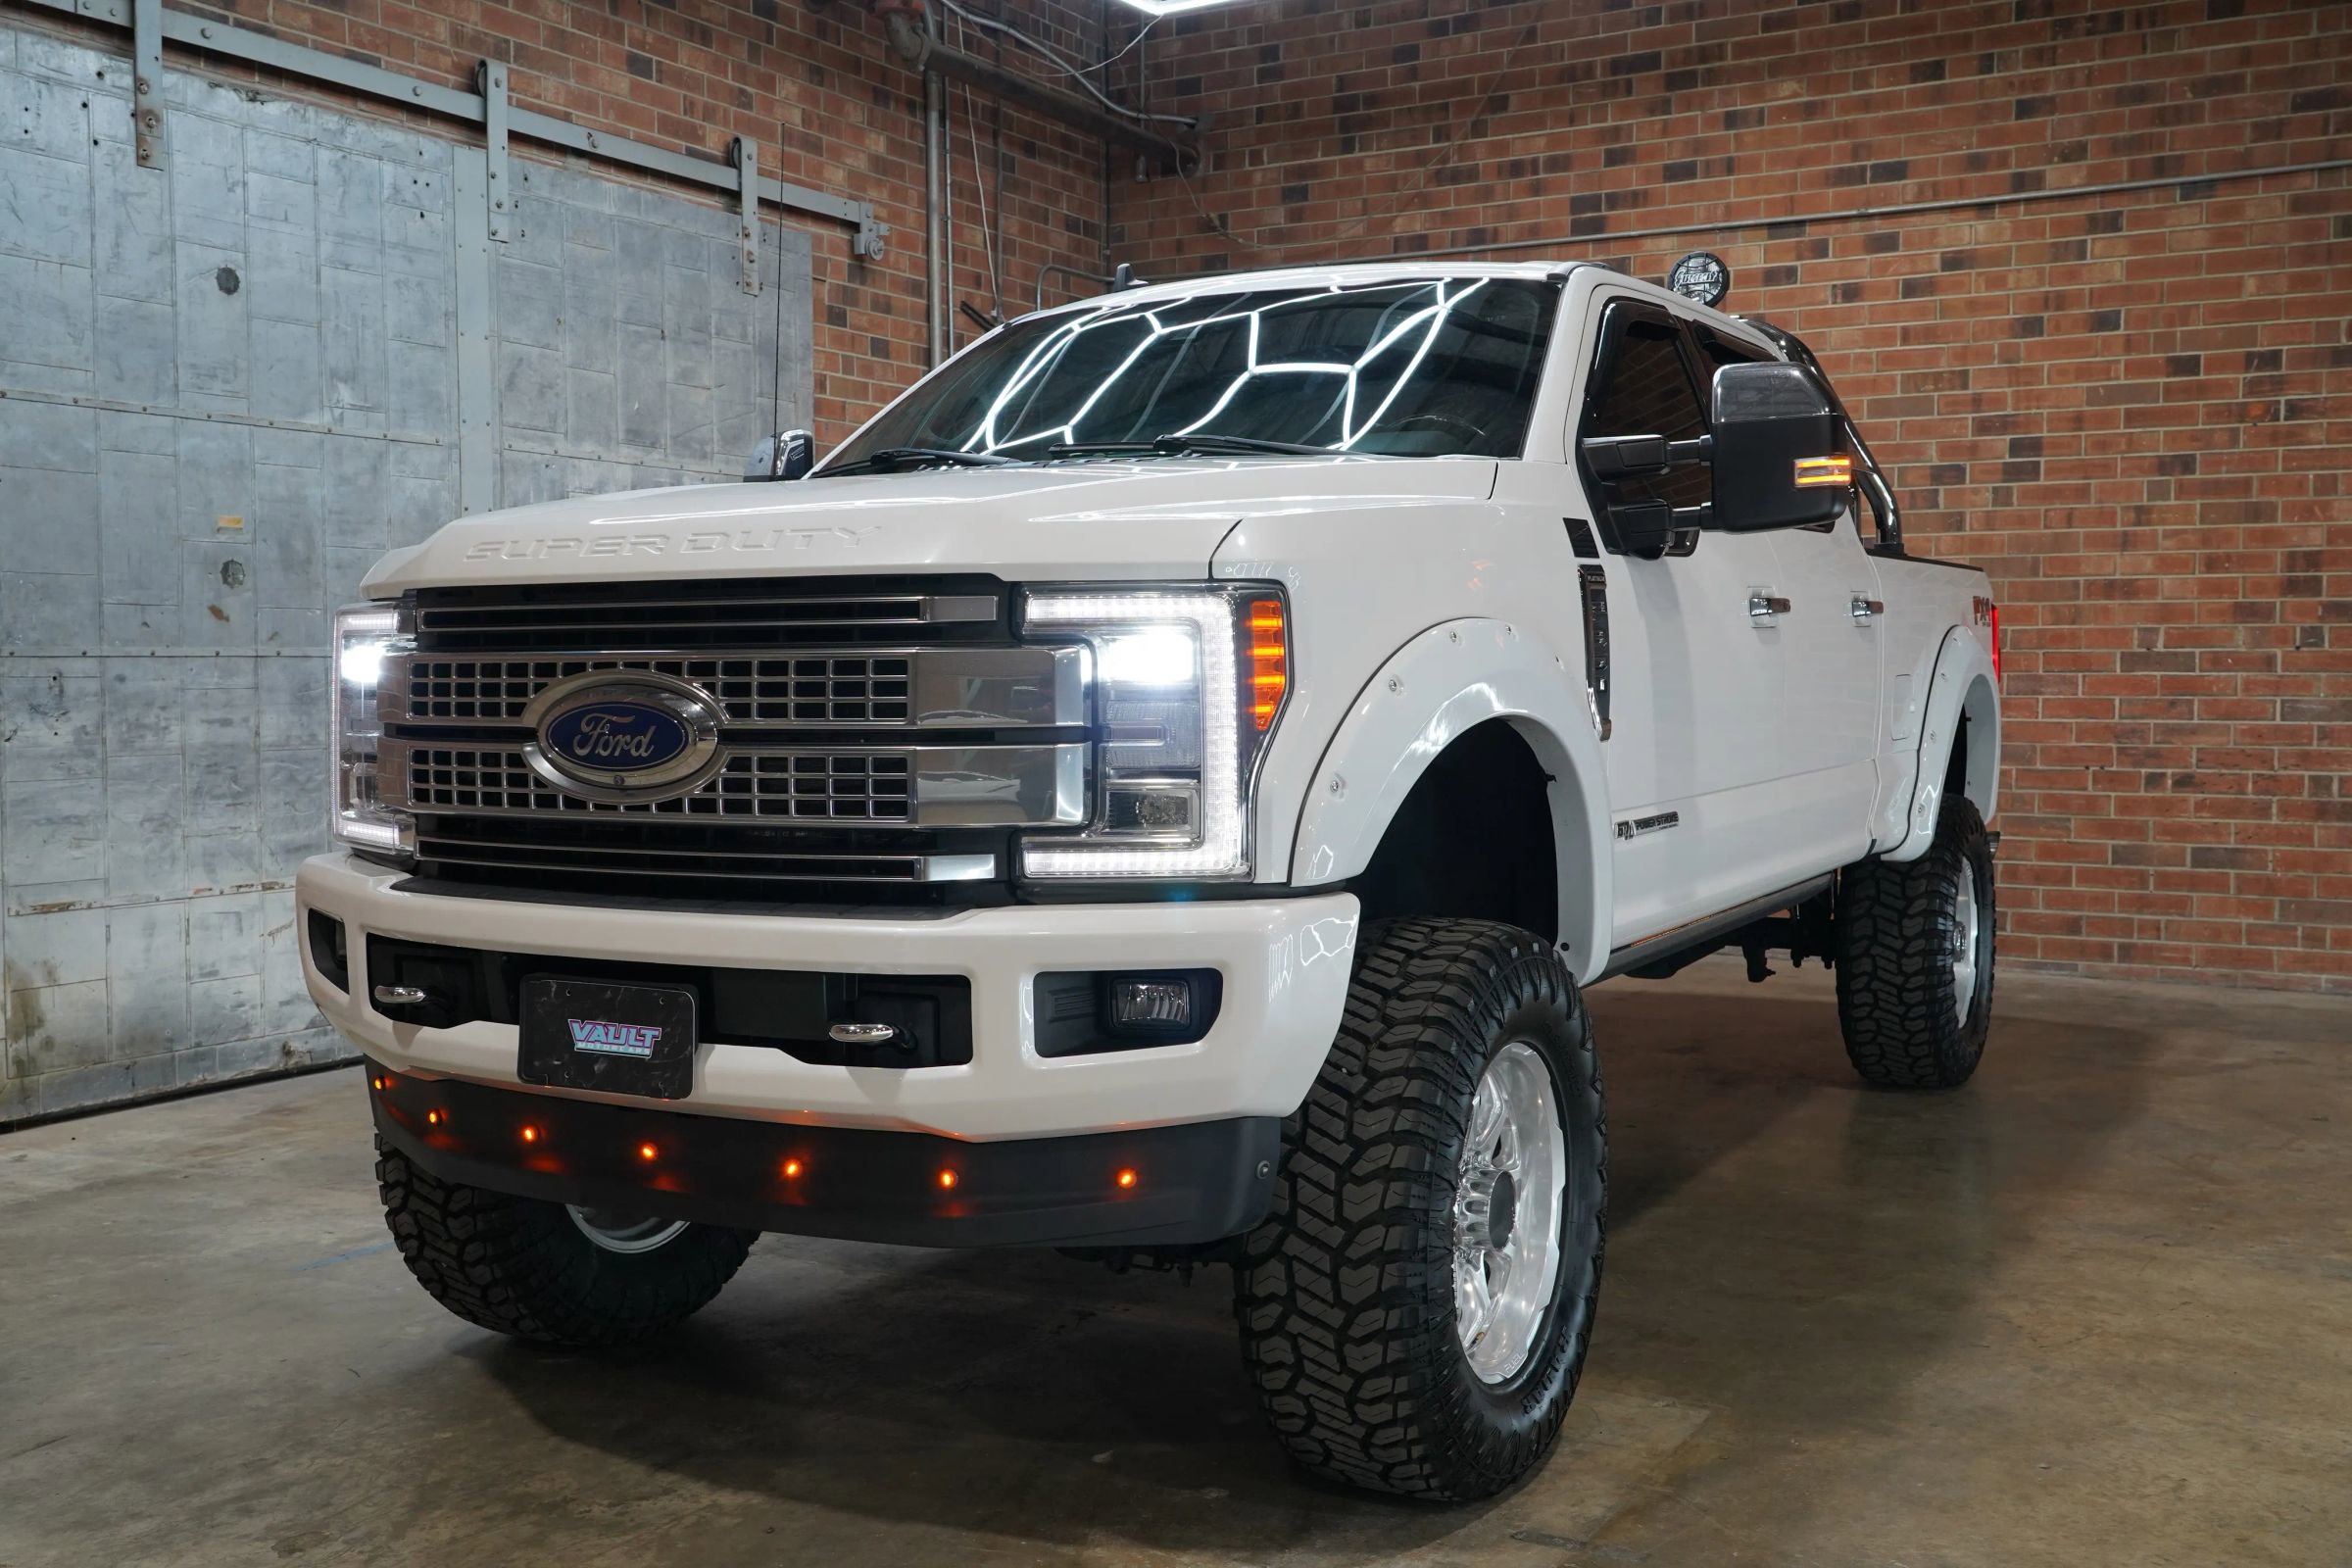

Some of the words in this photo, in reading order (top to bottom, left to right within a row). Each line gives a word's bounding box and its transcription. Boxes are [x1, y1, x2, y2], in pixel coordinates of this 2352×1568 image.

[464, 534, 669, 562] SUPER
[679, 524, 881, 554] DUTY
[572, 712, 657, 758] Ford
[567, 1019, 662, 1048] VAULT
[1503, 1352, 1526, 1373] FUEL
